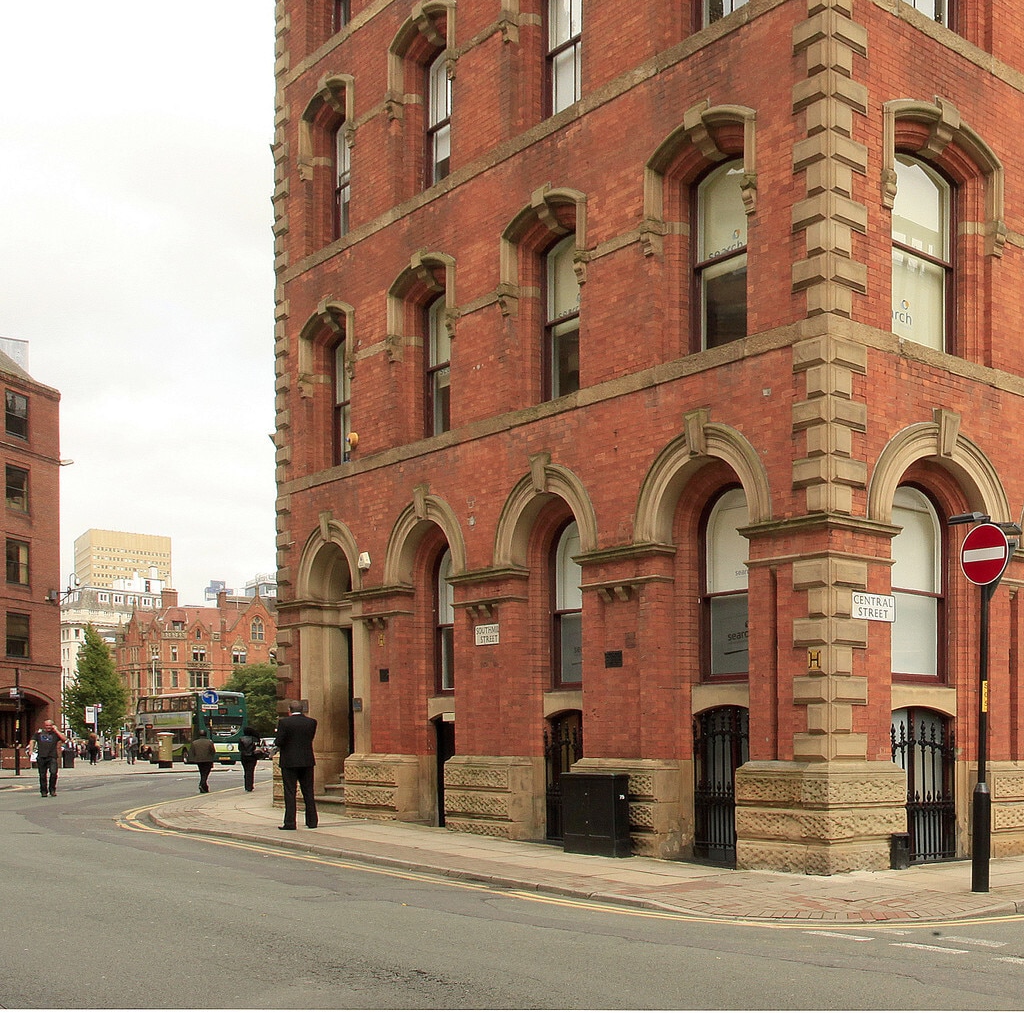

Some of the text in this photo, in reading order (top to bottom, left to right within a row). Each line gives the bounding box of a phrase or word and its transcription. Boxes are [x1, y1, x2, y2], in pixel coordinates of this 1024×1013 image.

[853, 594, 893, 607] CENTRAL
[858, 607, 889, 619] STREET
[480, 635, 498, 644] STREET
[808, 650, 821, 669] H
